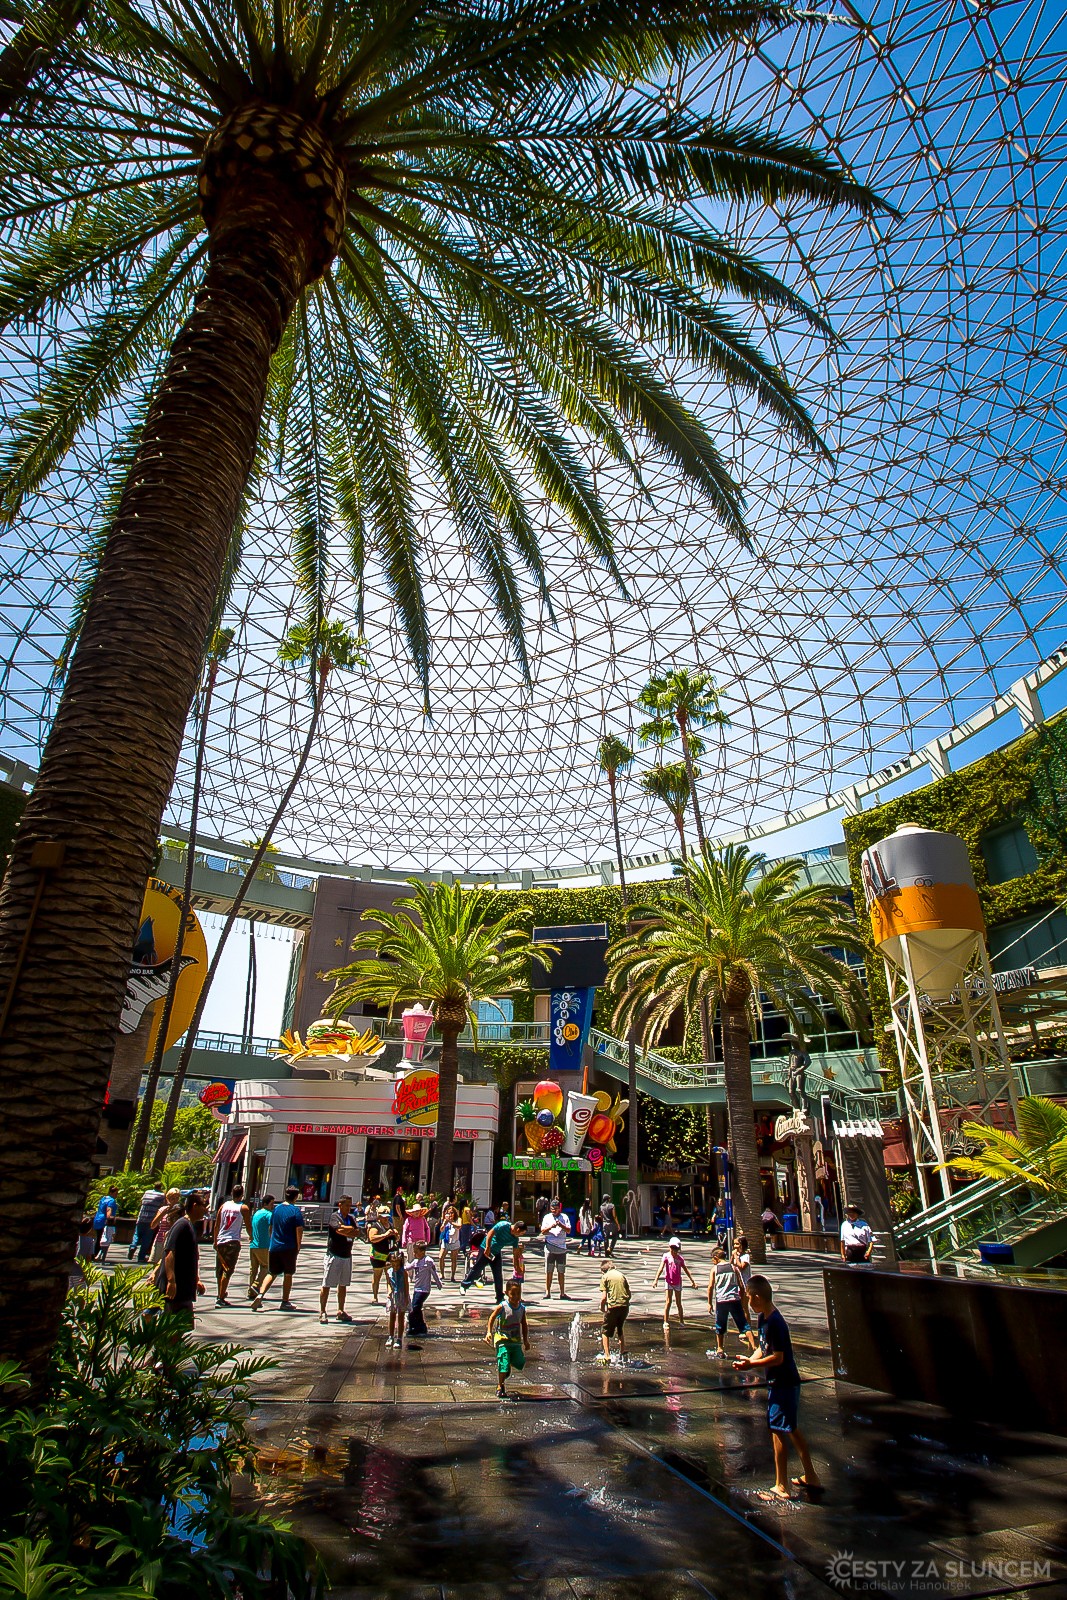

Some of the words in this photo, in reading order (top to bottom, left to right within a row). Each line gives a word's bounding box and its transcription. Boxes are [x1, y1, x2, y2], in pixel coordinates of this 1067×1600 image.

[151, 879, 175, 898] THE
[555, 993, 570, 1045] COMEDY
[394, 1074, 440, 1097] Johnny
[287, 1124, 313, 1133] BEER
[321, 1125, 395, 1136] HAMBURGERS
[403, 1128, 435, 1137] FRIES
[453, 1129, 479, 1139] ALTS
[503, 1153, 580, 1171] Jamba
